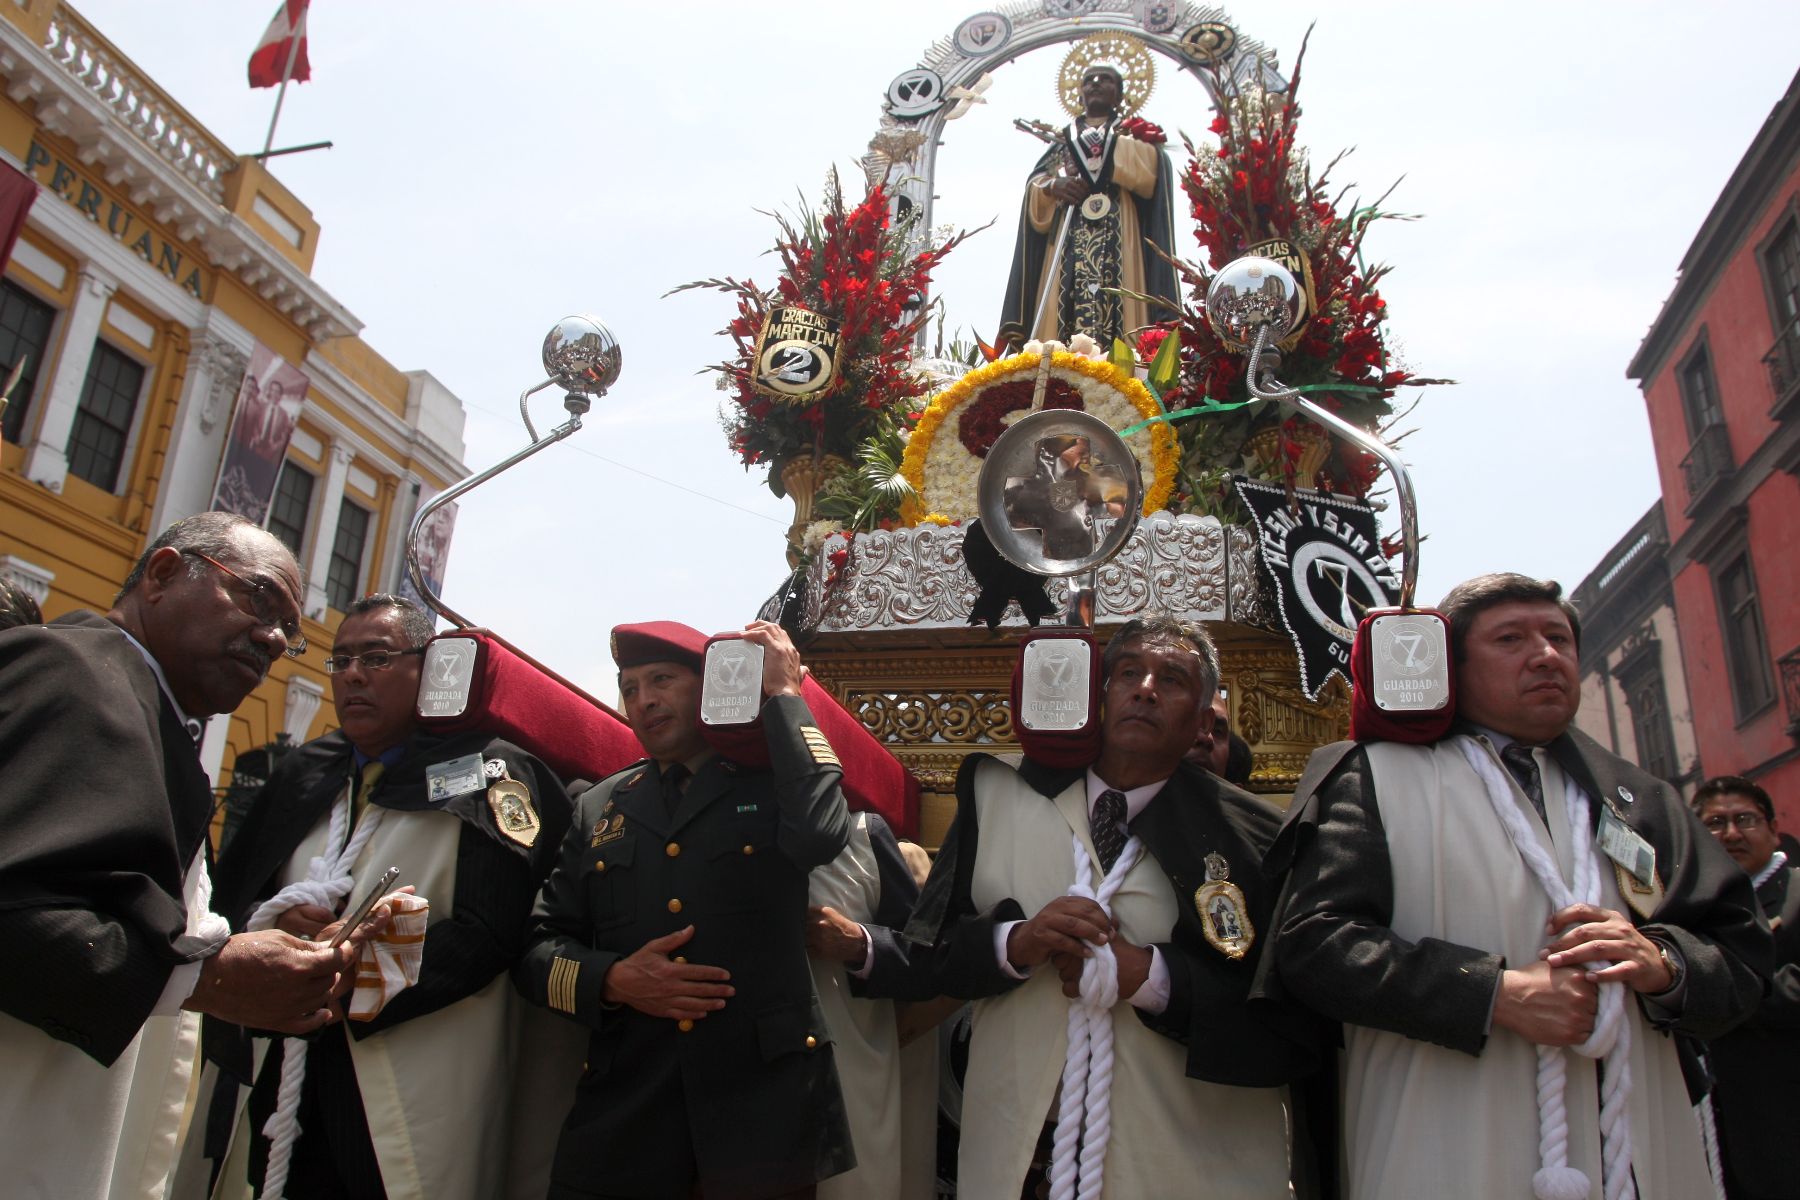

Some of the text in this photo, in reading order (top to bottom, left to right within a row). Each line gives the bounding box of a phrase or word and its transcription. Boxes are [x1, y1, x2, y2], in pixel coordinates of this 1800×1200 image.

[25, 139, 202, 299] PERUANA
[1243, 242, 1290, 257] ACIAS
[780, 308, 828, 330] GRACIAS
[767, 323, 835, 347] MARTIN
[783, 346, 812, 383] 2
[1395, 634, 1423, 667] 7
[1383, 679, 1439, 691] GUARDADA
[708, 695, 752, 708] GUARDADA
[1400, 691, 1424, 703] 2010
[432, 700, 450, 711] 2010
[720, 707, 741, 718] 2010
